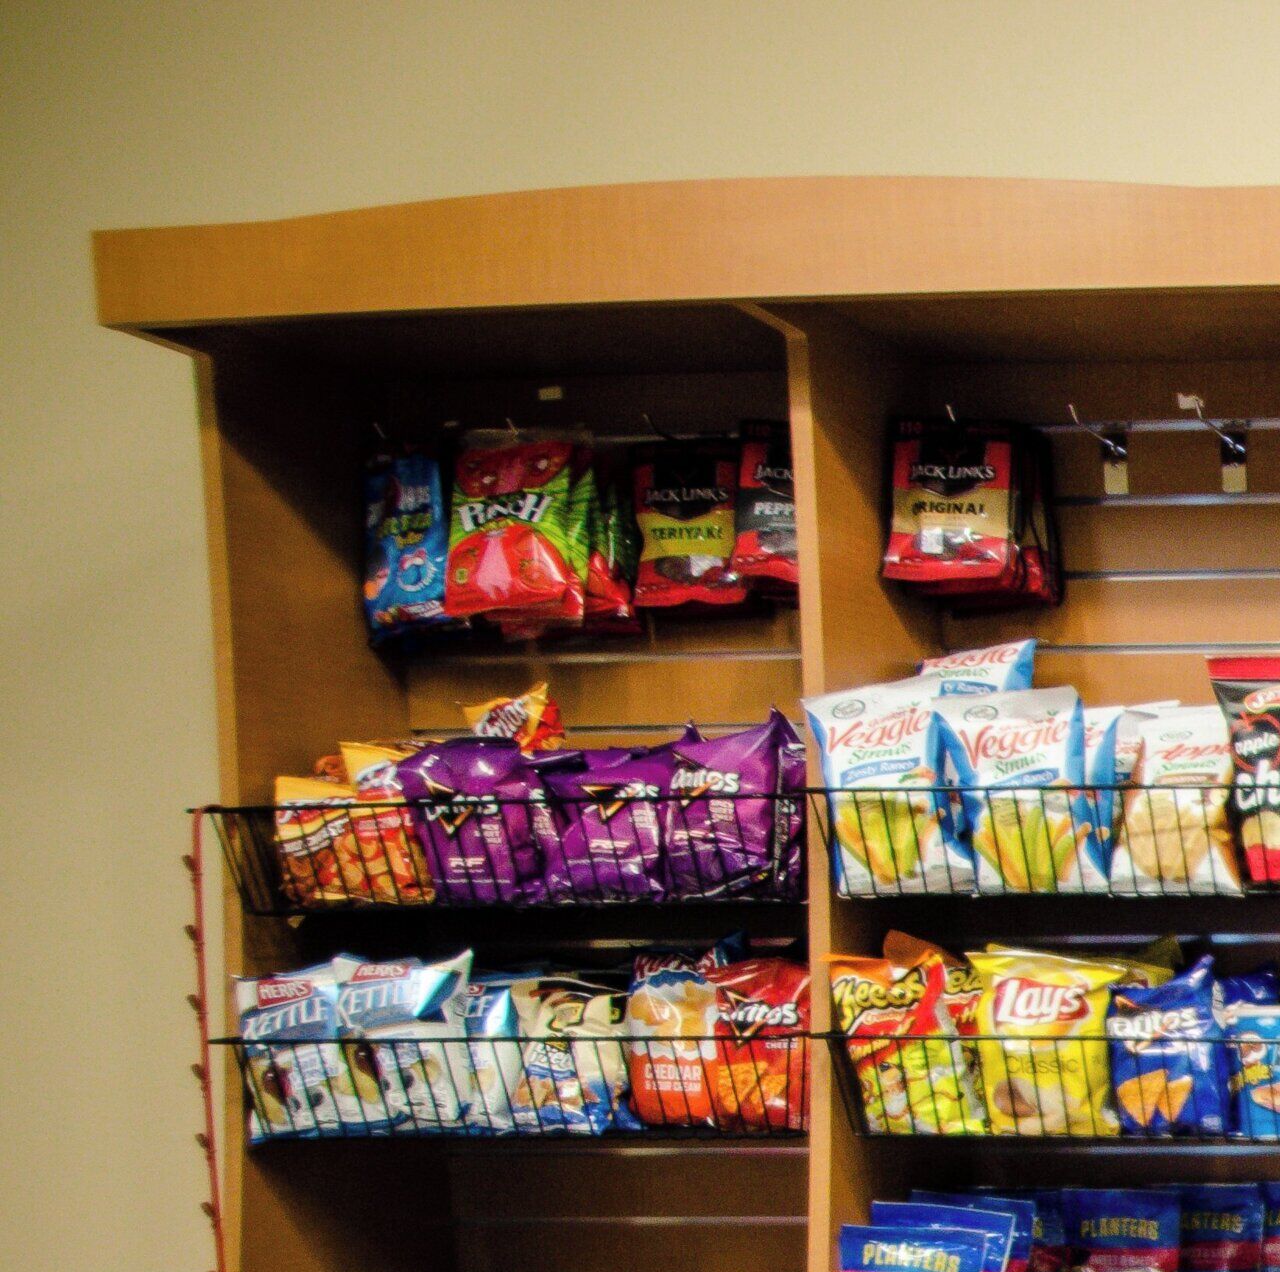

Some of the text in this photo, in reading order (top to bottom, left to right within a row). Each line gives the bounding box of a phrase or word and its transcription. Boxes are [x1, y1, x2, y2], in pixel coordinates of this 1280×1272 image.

[911, 464, 947, 481] JACK
[828, 706, 932, 755] Veggie
[959, 718, 1069, 771] Veggie
[1005, 1055, 1079, 1075] Classic
[1079, 1217, 1160, 1241] PLANTERS
